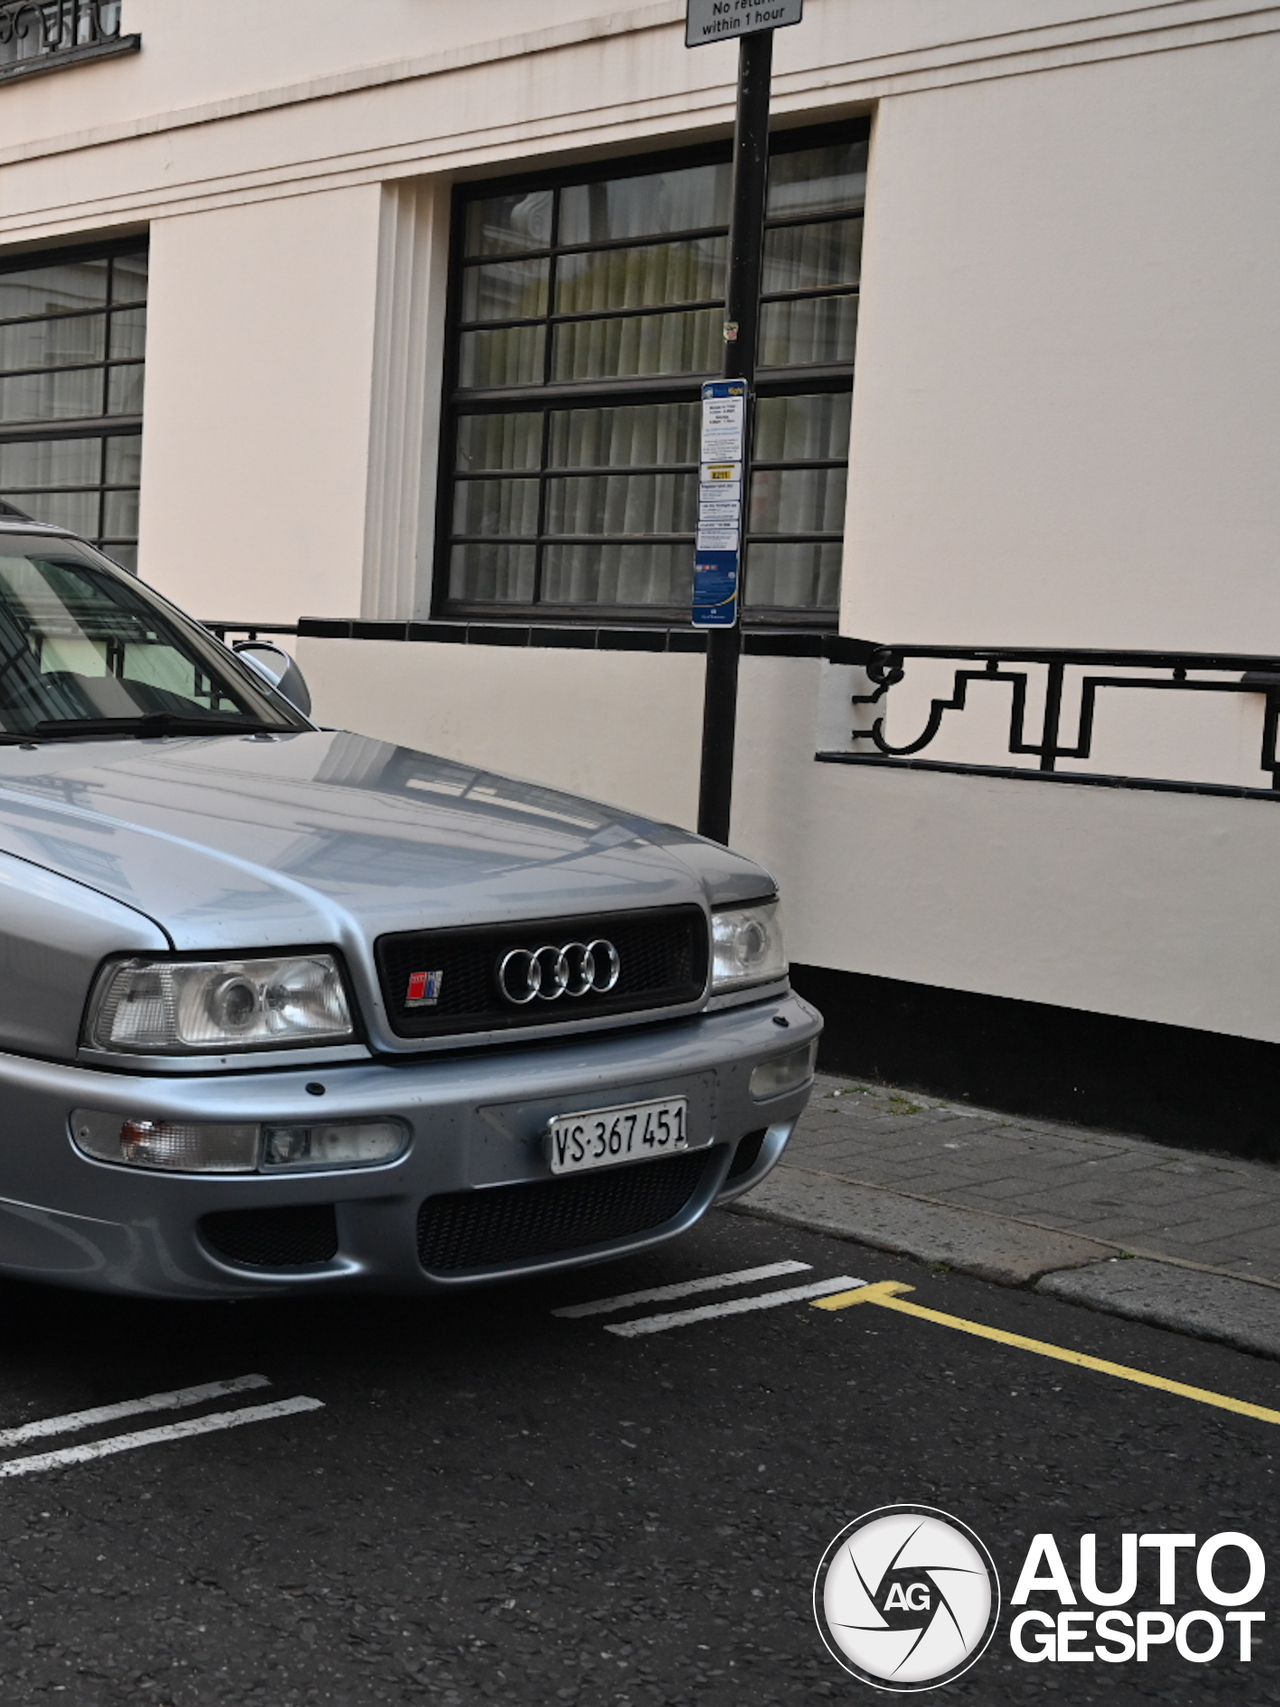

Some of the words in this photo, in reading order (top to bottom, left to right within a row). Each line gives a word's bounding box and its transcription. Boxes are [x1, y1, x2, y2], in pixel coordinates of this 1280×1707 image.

[712, 1, 731, 16] No
[702, 17, 741, 35] within
[745, 12, 751, 25] 1
[755, 7, 786, 24] hour
